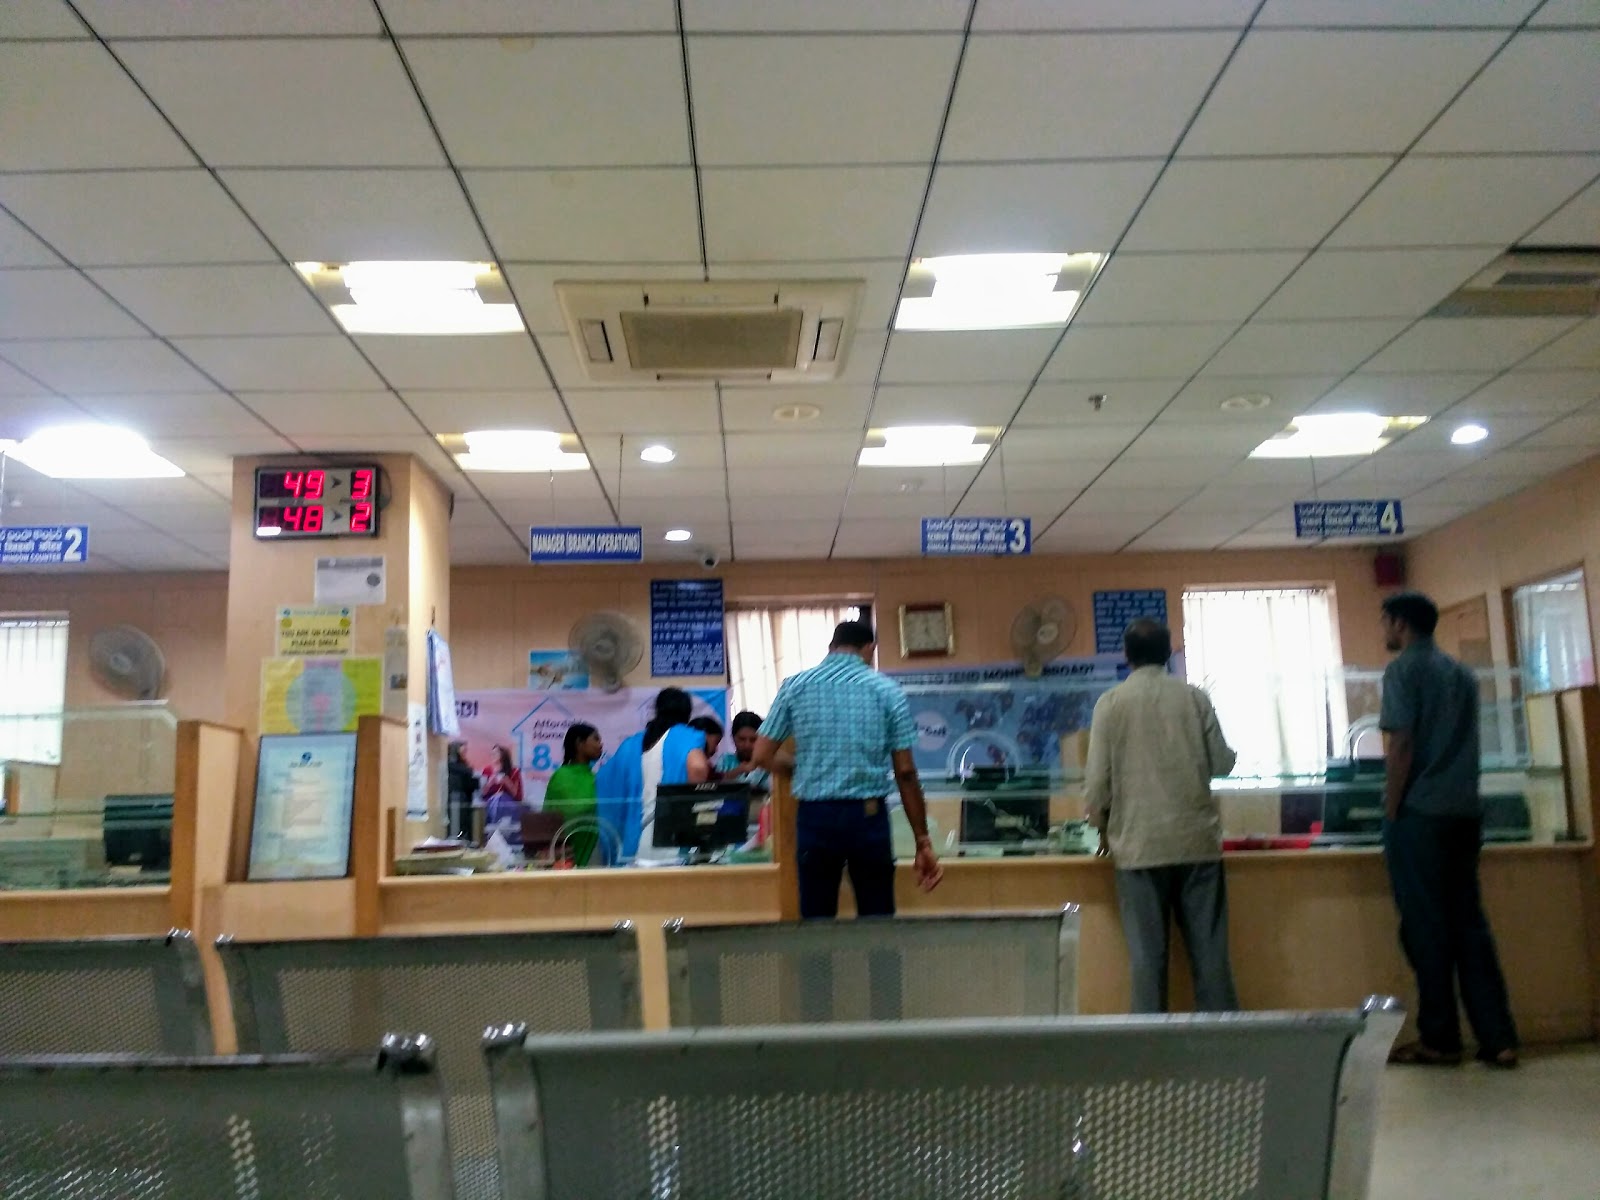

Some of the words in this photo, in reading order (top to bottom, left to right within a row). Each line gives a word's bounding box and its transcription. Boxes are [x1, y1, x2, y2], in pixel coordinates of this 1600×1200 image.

[284, 470, 325, 499] 49
[351, 470, 372, 499] 3
[283, 505, 323, 532] 48
[350, 502, 372, 532] 2
[1380, 501, 1398, 534] 4
[63, 528, 82, 562] 2
[532, 534, 565, 553] MANAGER
[1009, 519, 1026, 554] 3
[30, 552, 62, 562] COUNTER
[983, 667, 1025, 681] MONE
